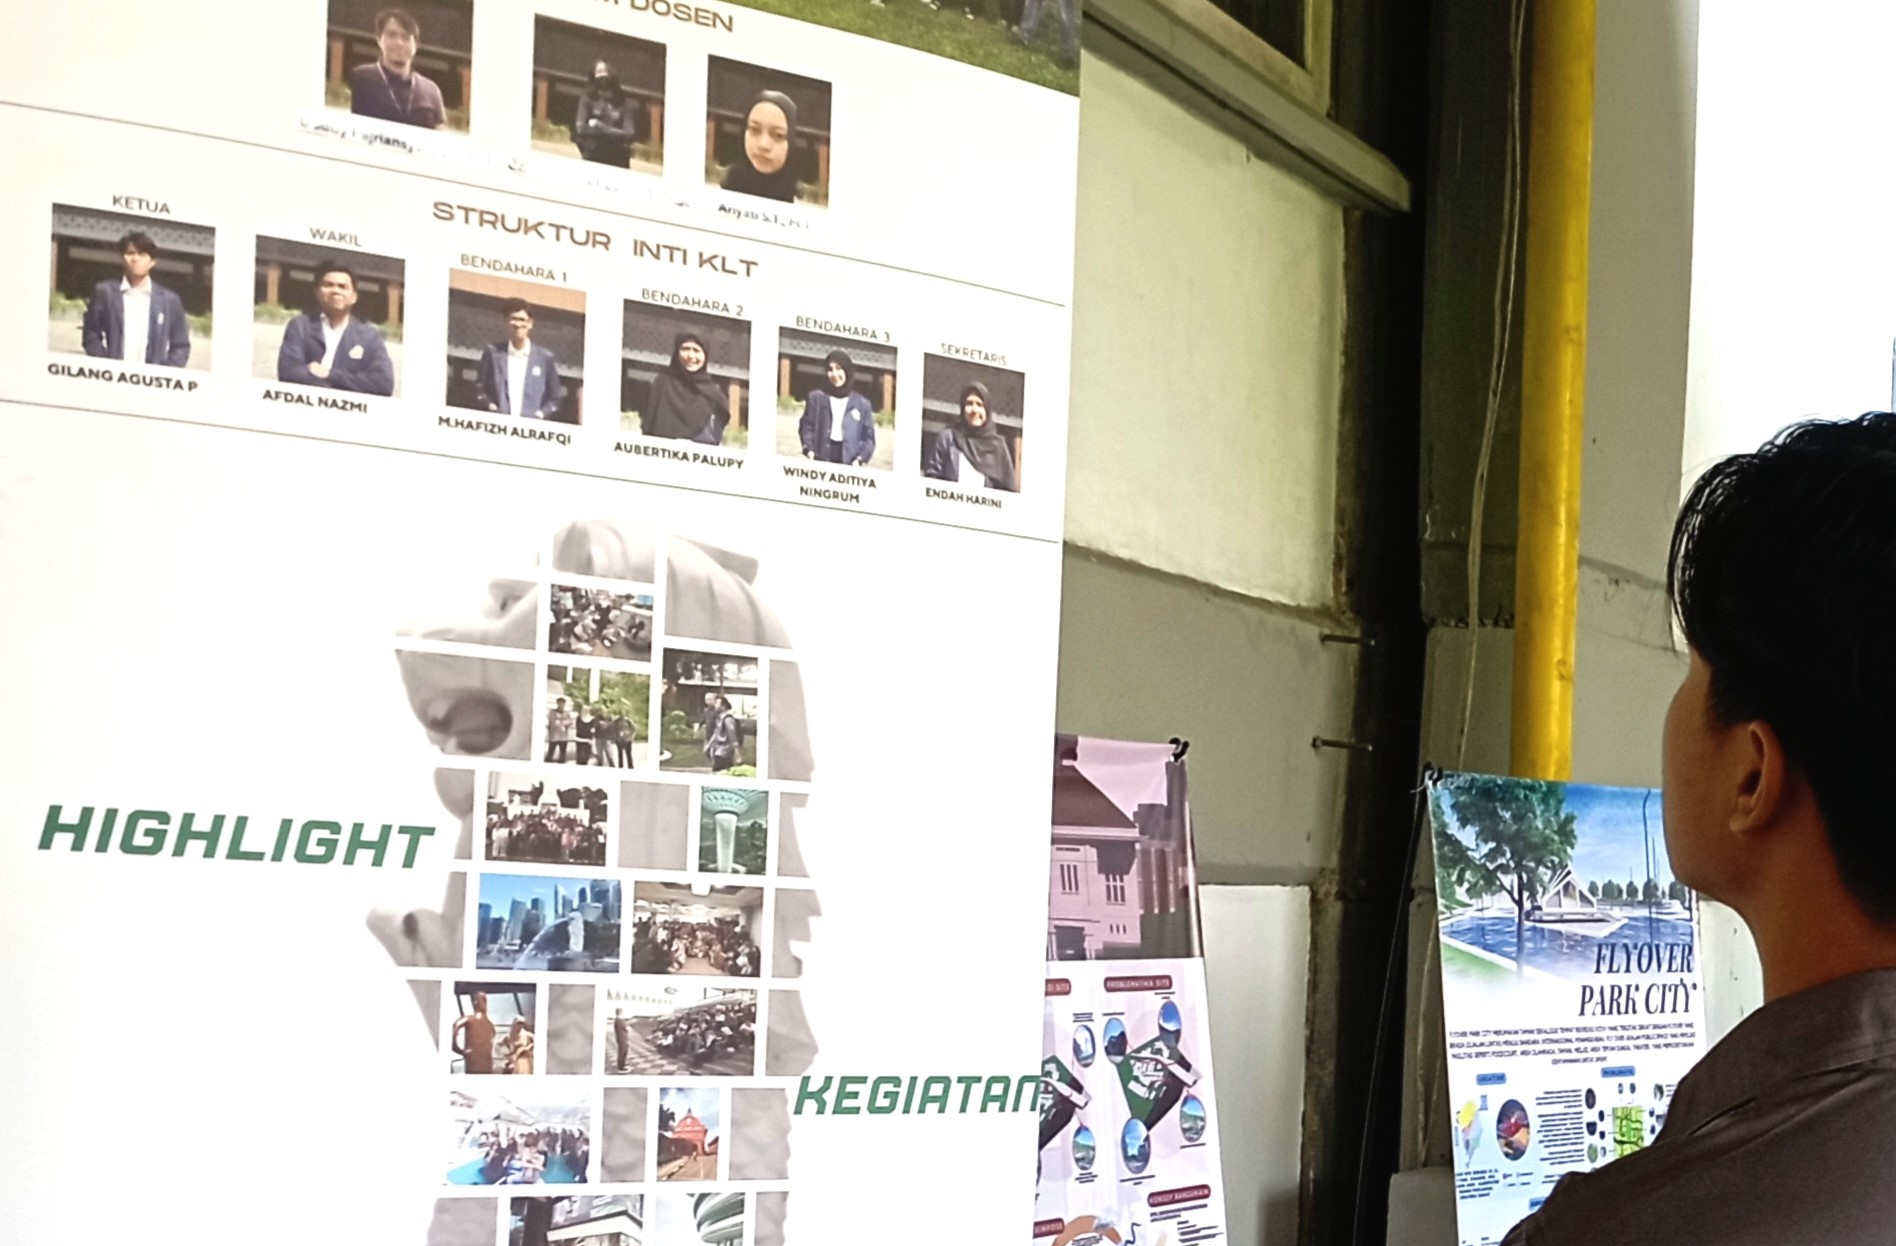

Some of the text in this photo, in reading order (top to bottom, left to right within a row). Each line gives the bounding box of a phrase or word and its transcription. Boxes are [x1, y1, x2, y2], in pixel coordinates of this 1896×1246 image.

[112, 194, 170, 215] KETUA
[309, 227, 362, 247] WAKIL
[433, 201, 758, 278] STRUKTUR INTI KLT
[461, 253, 569, 283] BENDAHARA 1
[641, 287, 744, 317] BENDAHARA 2
[796, 314, 892, 343] BENDAHARA 3
[940, 342, 1007, 365] SEKRETARIS
[48, 362, 198, 393] GILANG AGUSTA P
[262, 389, 368, 413] AFDAL NAZMI
[438, 415, 571, 445] M.HAFIZH ALRAFQI
[614, 441, 744, 470] AUBERTIKA PALUPY
[783, 465, 826, 483] WINDY
[799, 486, 860, 503] NINGRUM
[925, 487, 1002, 508] ENDAH HARINI
[37, 803, 438, 869] HIGHLIGHT
[1594, 941, 1696, 976] FLYOVER
[1578, 976, 1699, 1017] PARK CITY
[792, 1074, 1043, 1115] KEGIATAN
